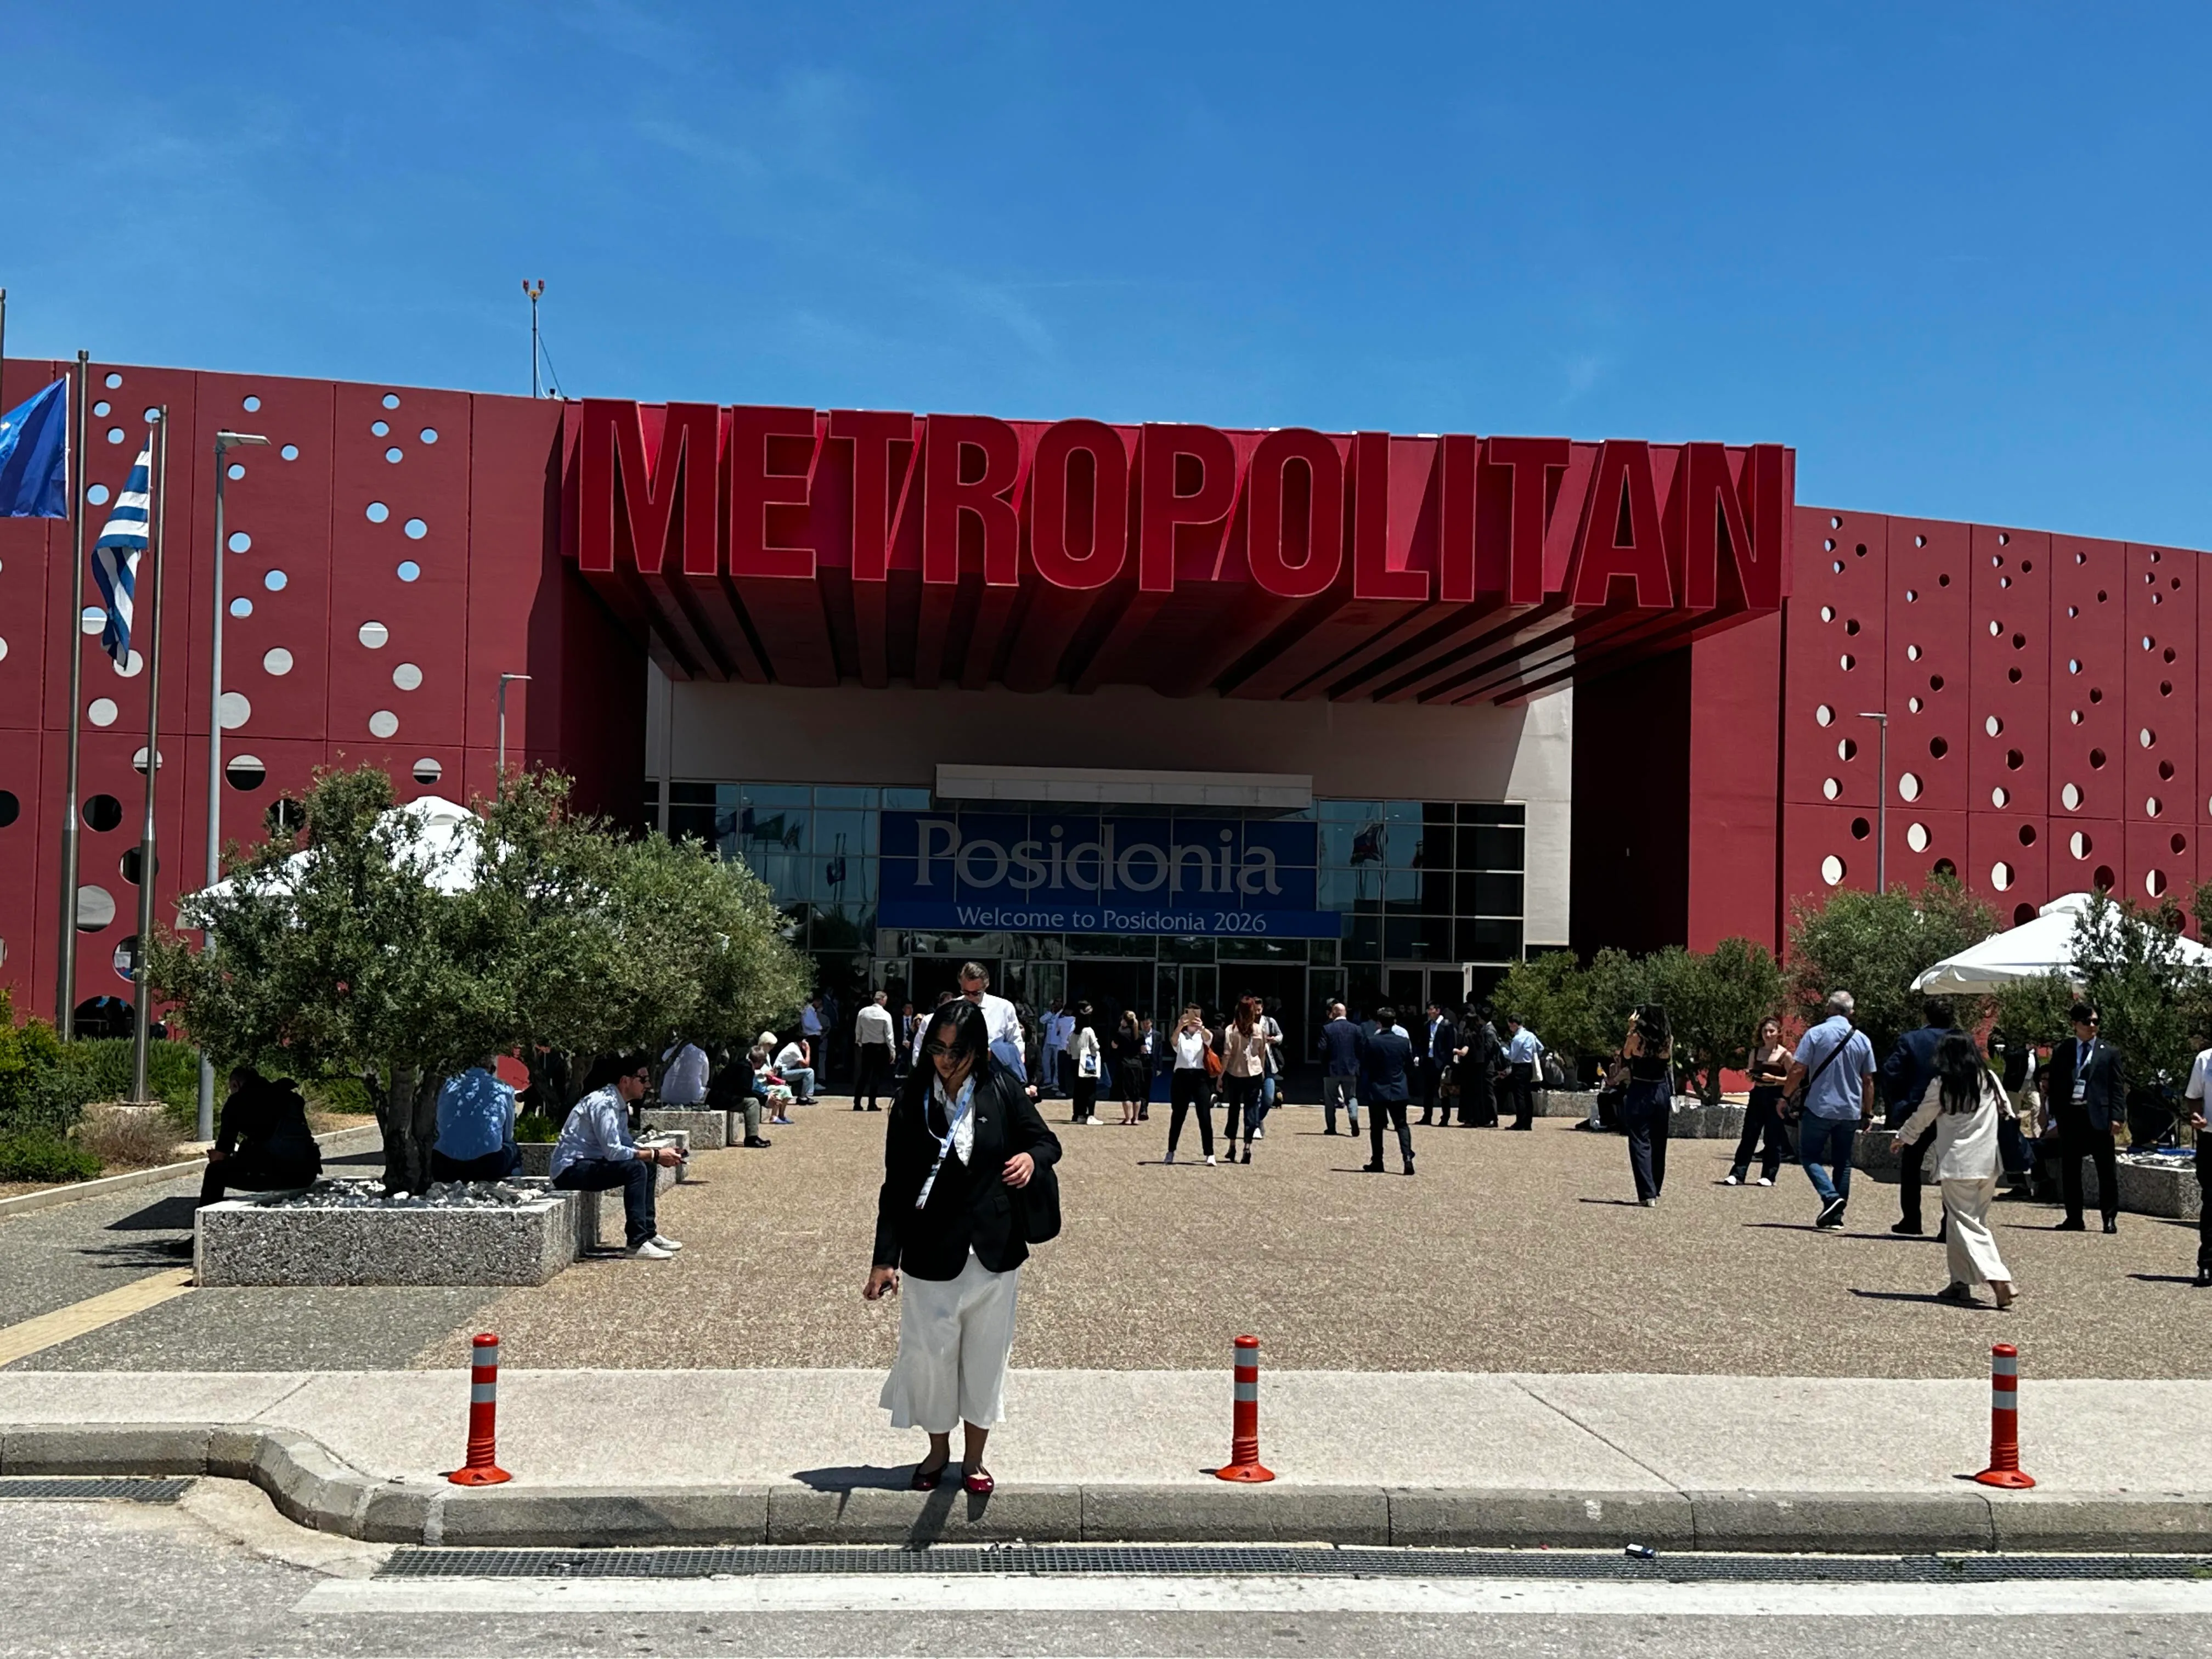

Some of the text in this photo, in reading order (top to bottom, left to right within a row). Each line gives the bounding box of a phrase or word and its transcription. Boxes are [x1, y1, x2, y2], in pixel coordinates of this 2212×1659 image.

[579, 398, 1784, 610] METROPOLITAN
[913, 819, 1283, 895] Posidonia
[956, 906, 1267, 933] Welcome to Posidonia 2026
